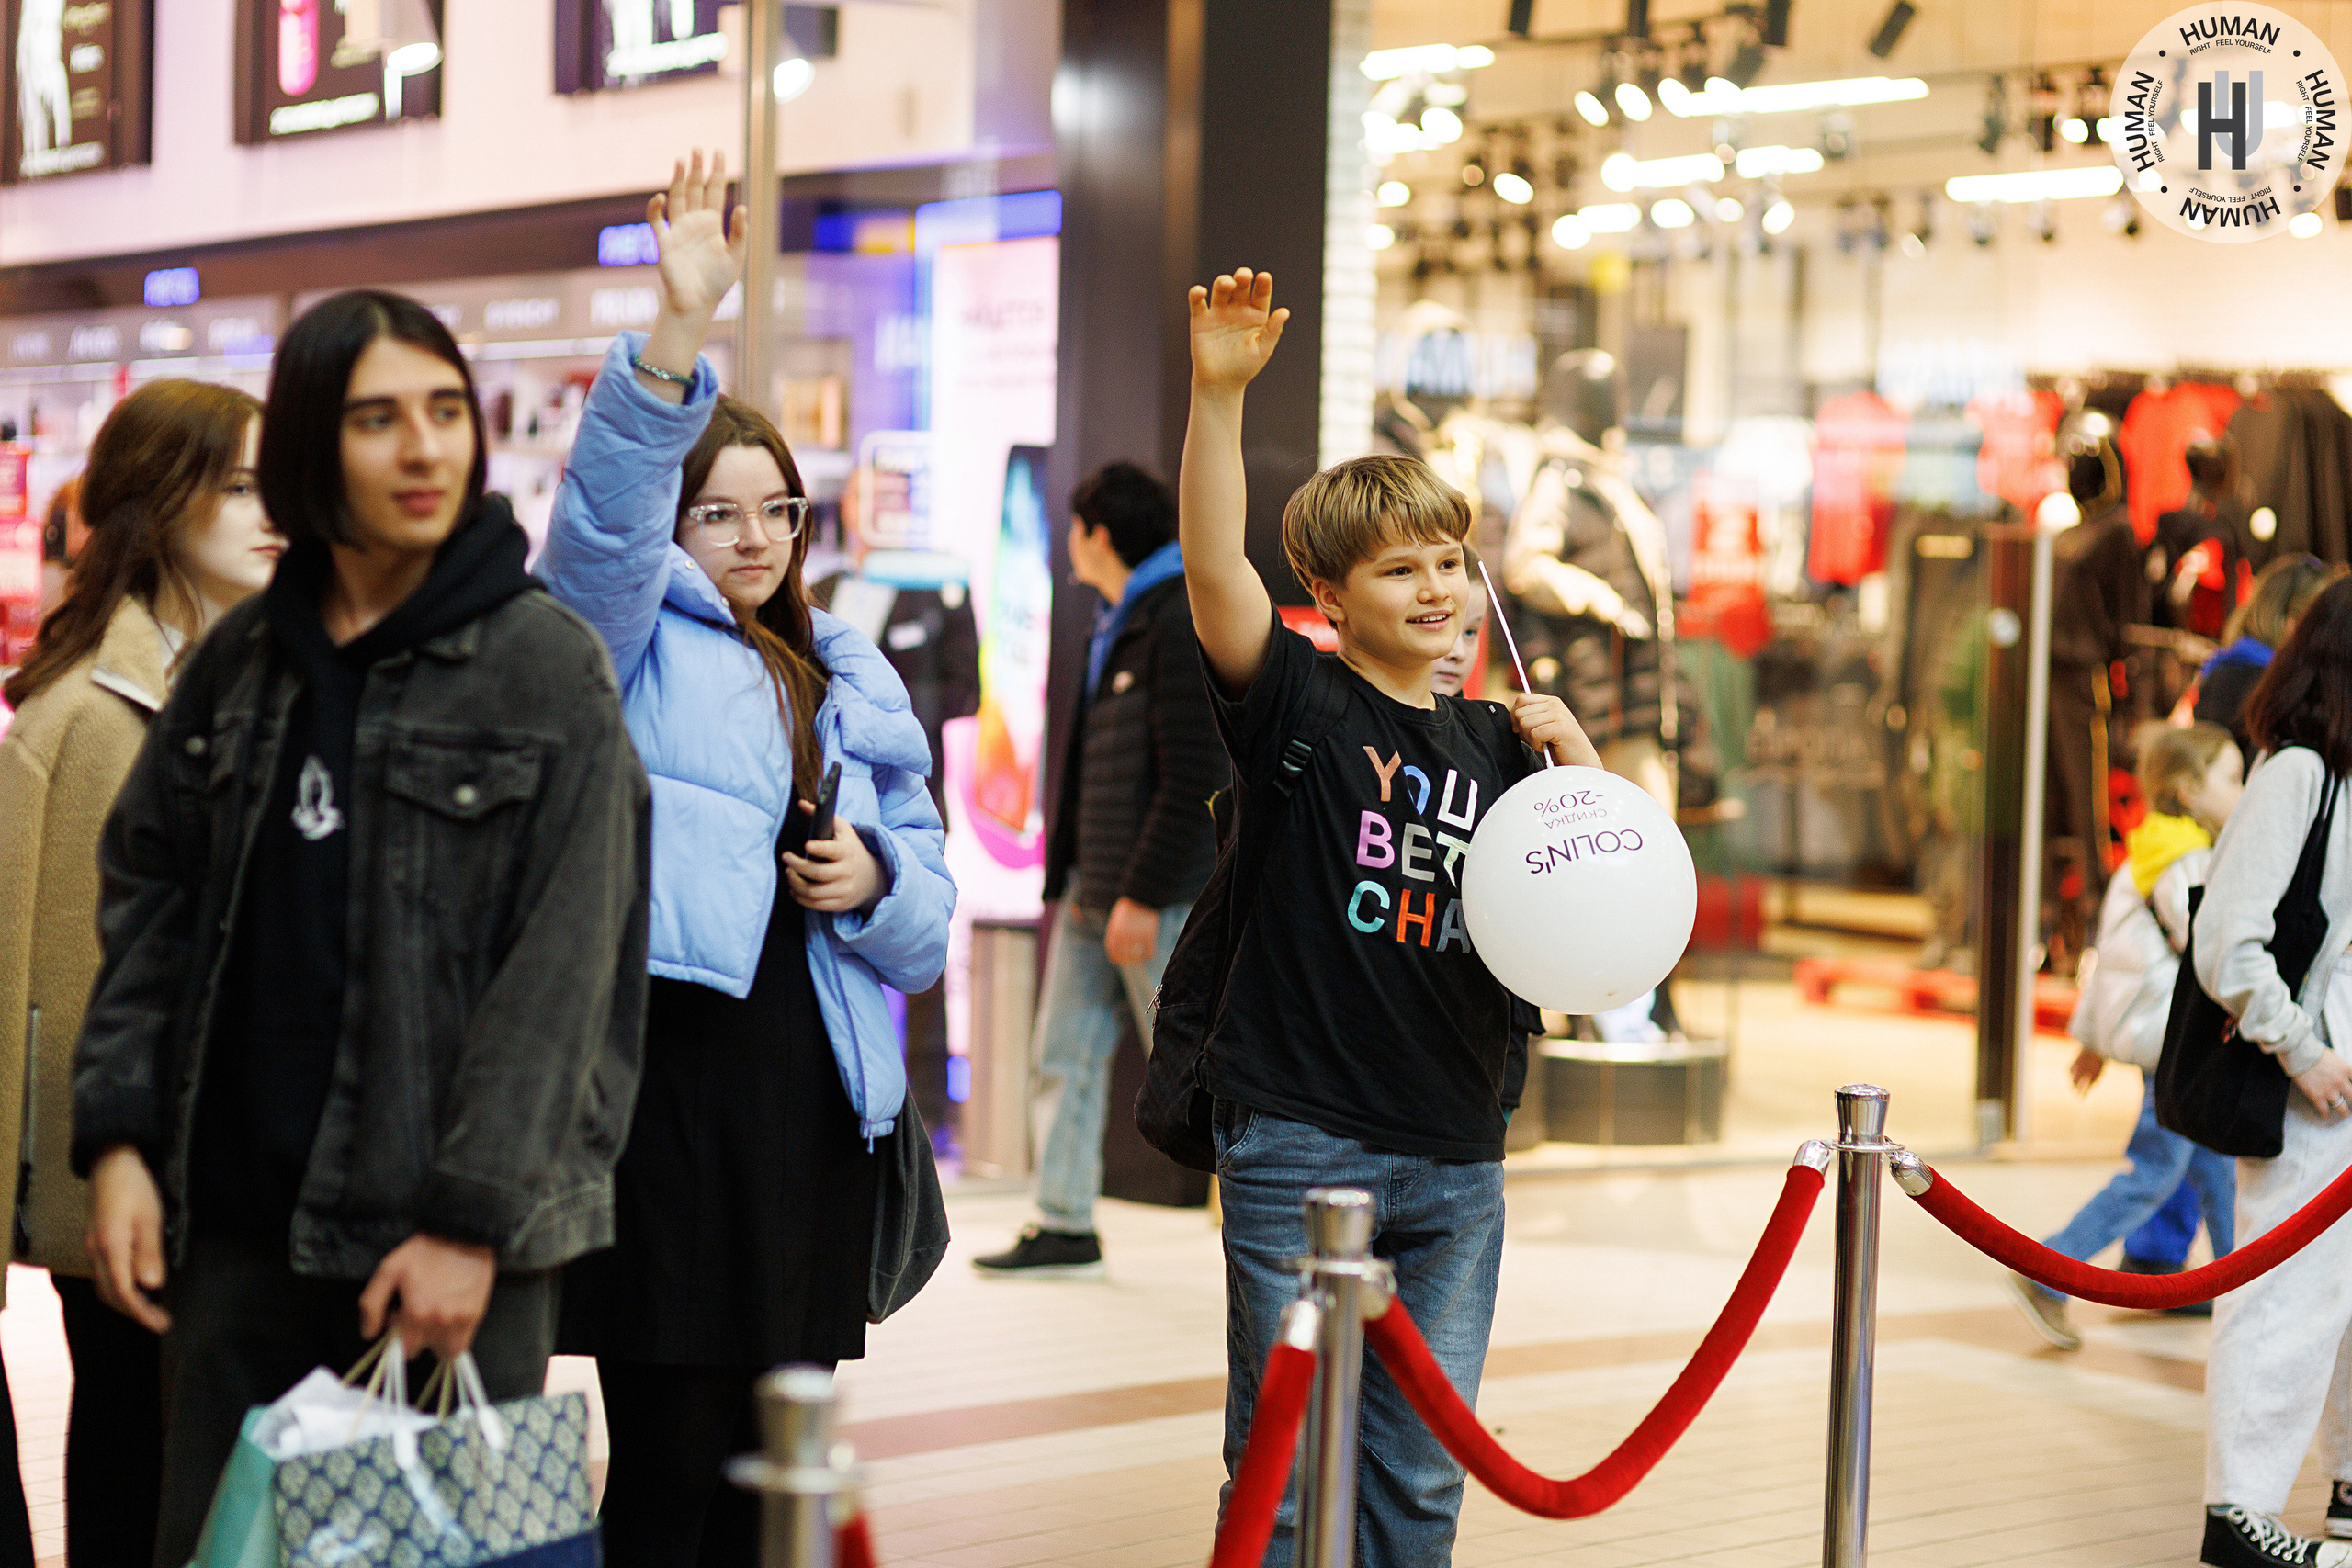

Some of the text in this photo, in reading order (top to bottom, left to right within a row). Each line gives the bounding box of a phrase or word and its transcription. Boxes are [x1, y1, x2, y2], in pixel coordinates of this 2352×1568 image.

[1363, 745, 1478, 832] YOU
[1533, 790, 1604, 817] -20%
[1544, 808, 1608, 829] СКИДКА
[1356, 809, 1470, 889] BET
[1525, 829, 1643, 874] COLIN'S
[1347, 880, 1470, 954] CHA
